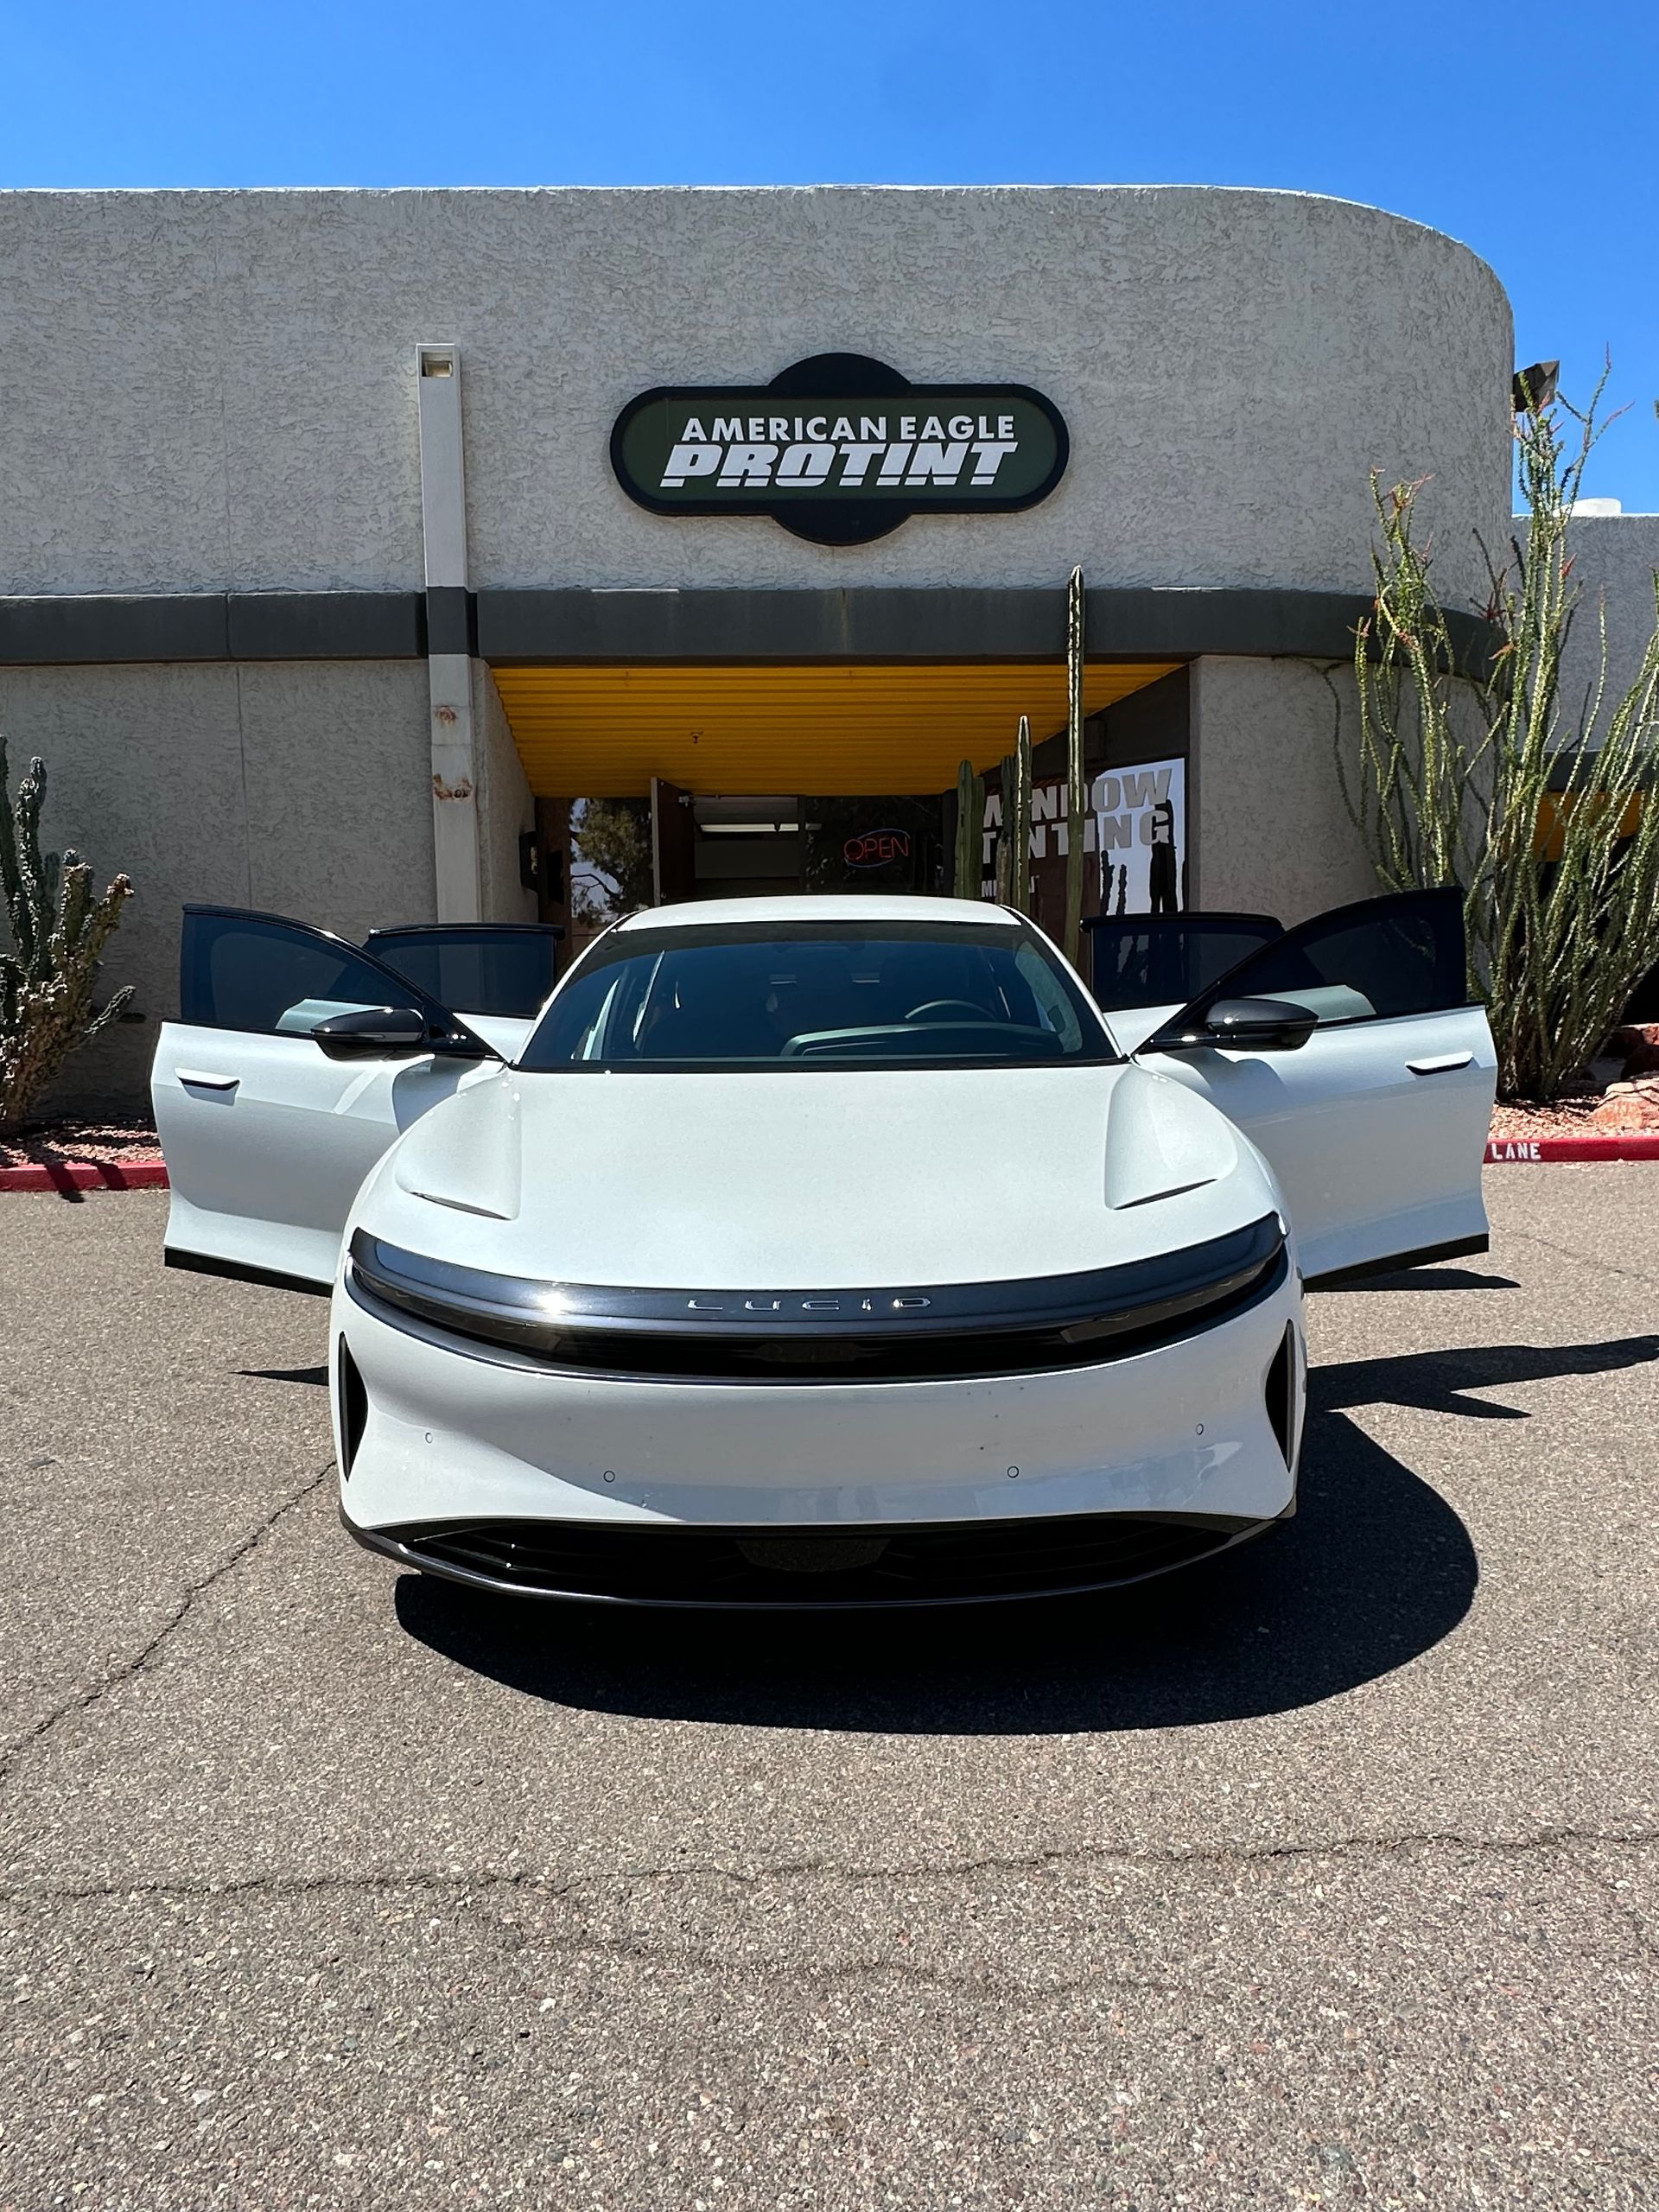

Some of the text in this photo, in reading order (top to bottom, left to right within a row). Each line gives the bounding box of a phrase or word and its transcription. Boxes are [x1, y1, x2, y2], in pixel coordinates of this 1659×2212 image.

[681, 415, 1015, 442] AMERICAN EAGLE
[659, 442, 1018, 488] PROTINT
[983, 768, 1173, 828] WNOW
[843, 836, 909, 861] OPEN
[982, 810, 1170, 864] TNTING
[1491, 1142, 1541, 1160] LANE
[688, 1297, 931, 1312] LUCID
